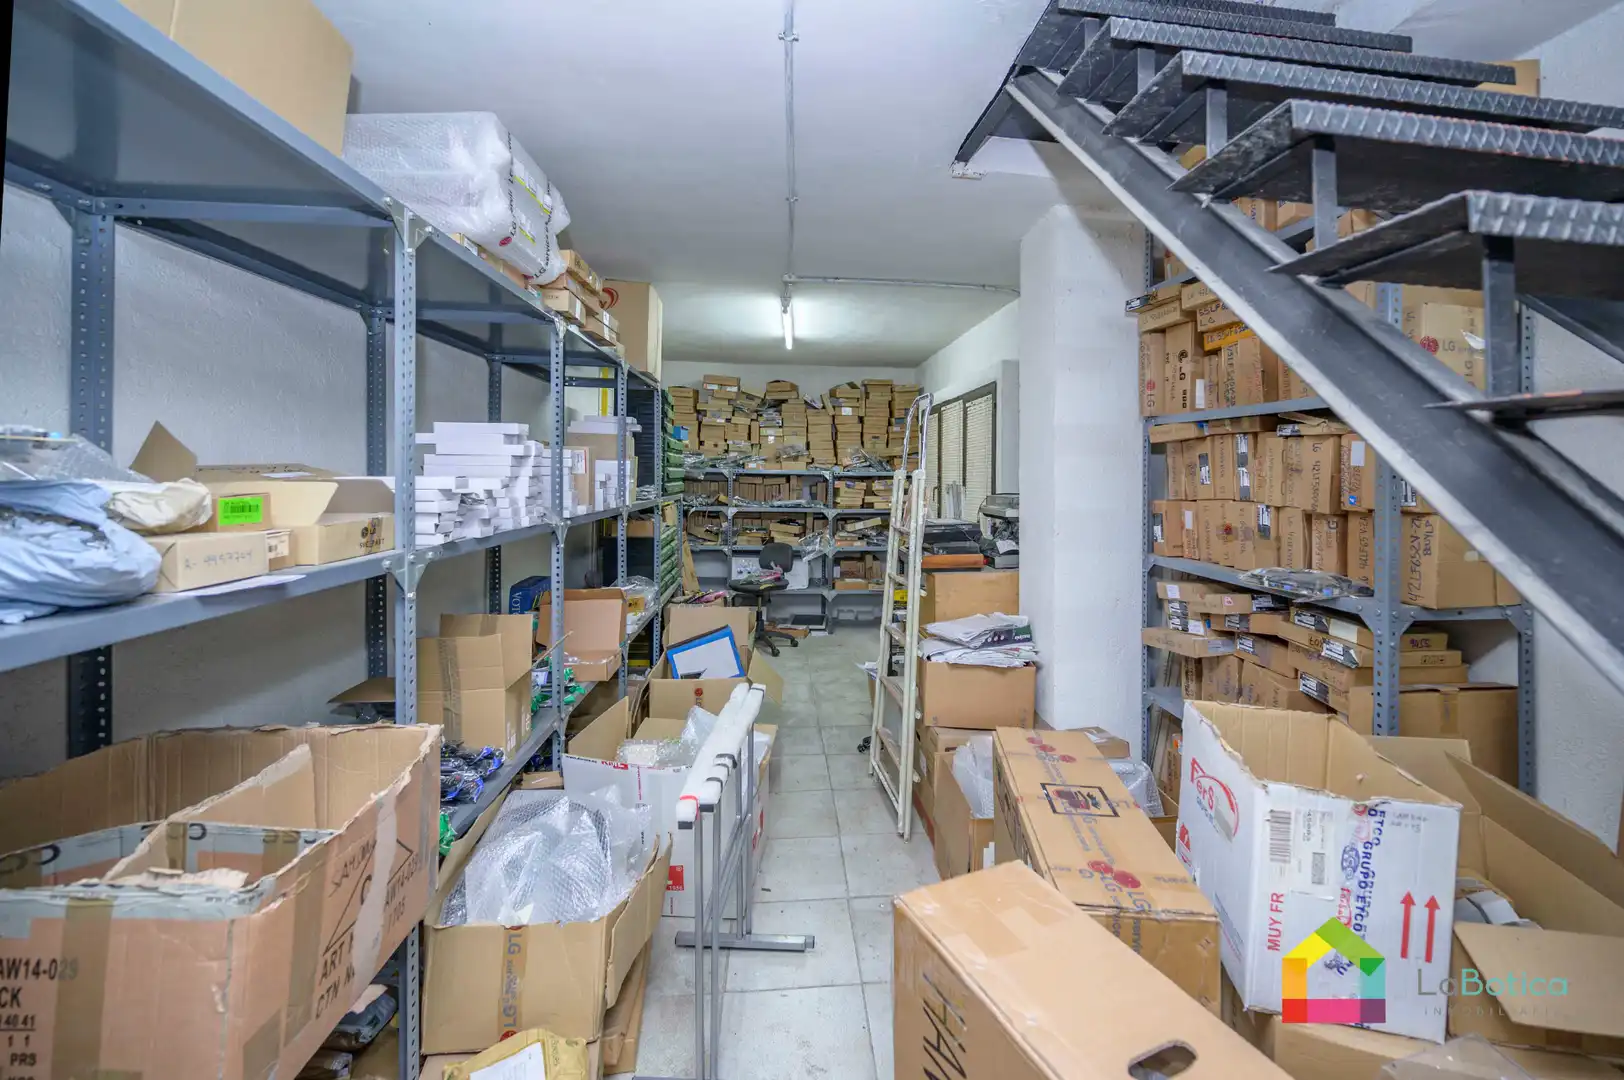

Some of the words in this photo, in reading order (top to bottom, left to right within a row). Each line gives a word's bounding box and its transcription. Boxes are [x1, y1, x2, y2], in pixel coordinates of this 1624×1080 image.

[534, 267, 547, 279] LG
[1442, 340, 1455, 352] LG
[512, 592, 522, 614] VOT
[1371, 809, 1387, 847] ETCO
[1356, 841, 1374, 890] GRUPO
[1352, 894, 1368, 933] ETCO
[508, 933, 522, 955] LG
[1267, 919, 1283, 952] MUY
[319, 940, 345, 986] ART
[315, 978, 341, 1020] CTN
[503, 1004, 517, 1028] LG
[10, 1051, 37, 1068] PRS
